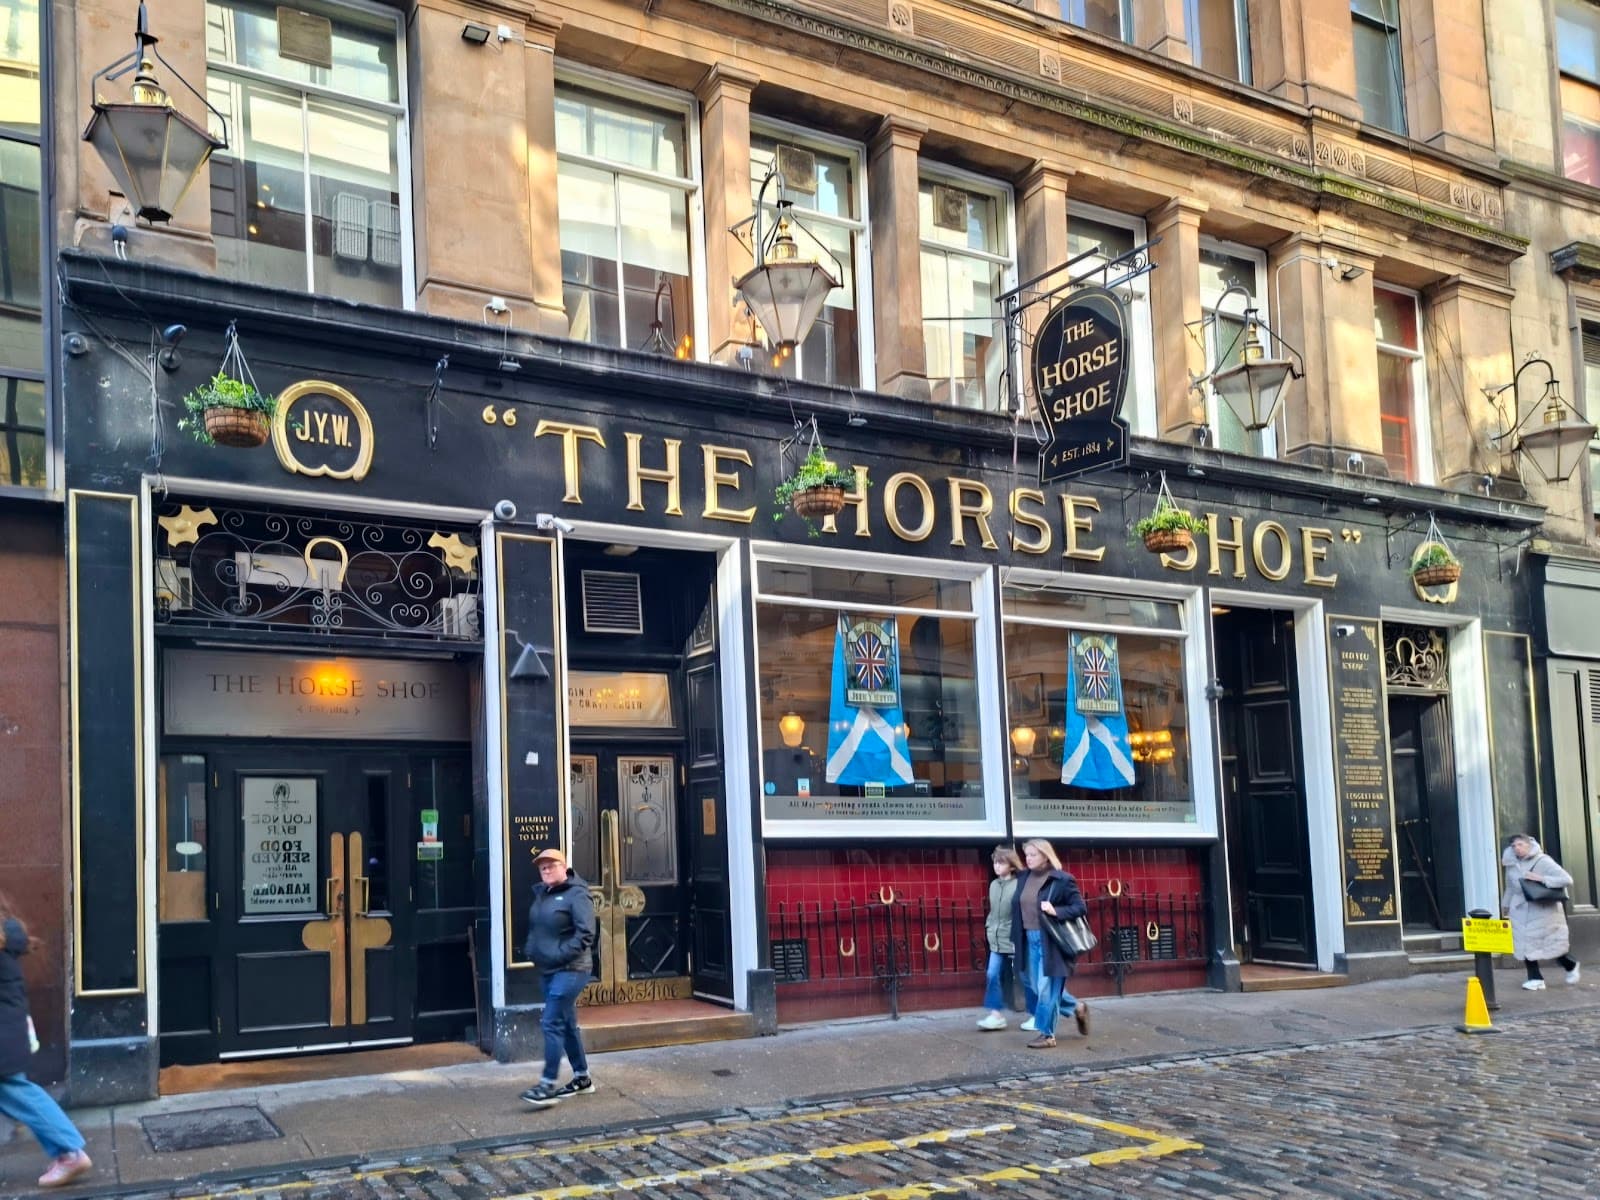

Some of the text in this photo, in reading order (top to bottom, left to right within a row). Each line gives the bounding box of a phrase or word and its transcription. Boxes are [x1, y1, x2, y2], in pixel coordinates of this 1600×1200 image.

[1064, 318, 1095, 344] THE
[1041, 338, 1119, 389] HORSE
[1053, 380, 1112, 423] SHOE
[295, 409, 352, 447] J.Y.W.
[1062, 447, 1080, 462] EST.
[821, 461, 1105, 561] HORSE
[206, 673, 442, 698] THE HORSE SHOE
[514, 816, 553, 824] DISABLED
